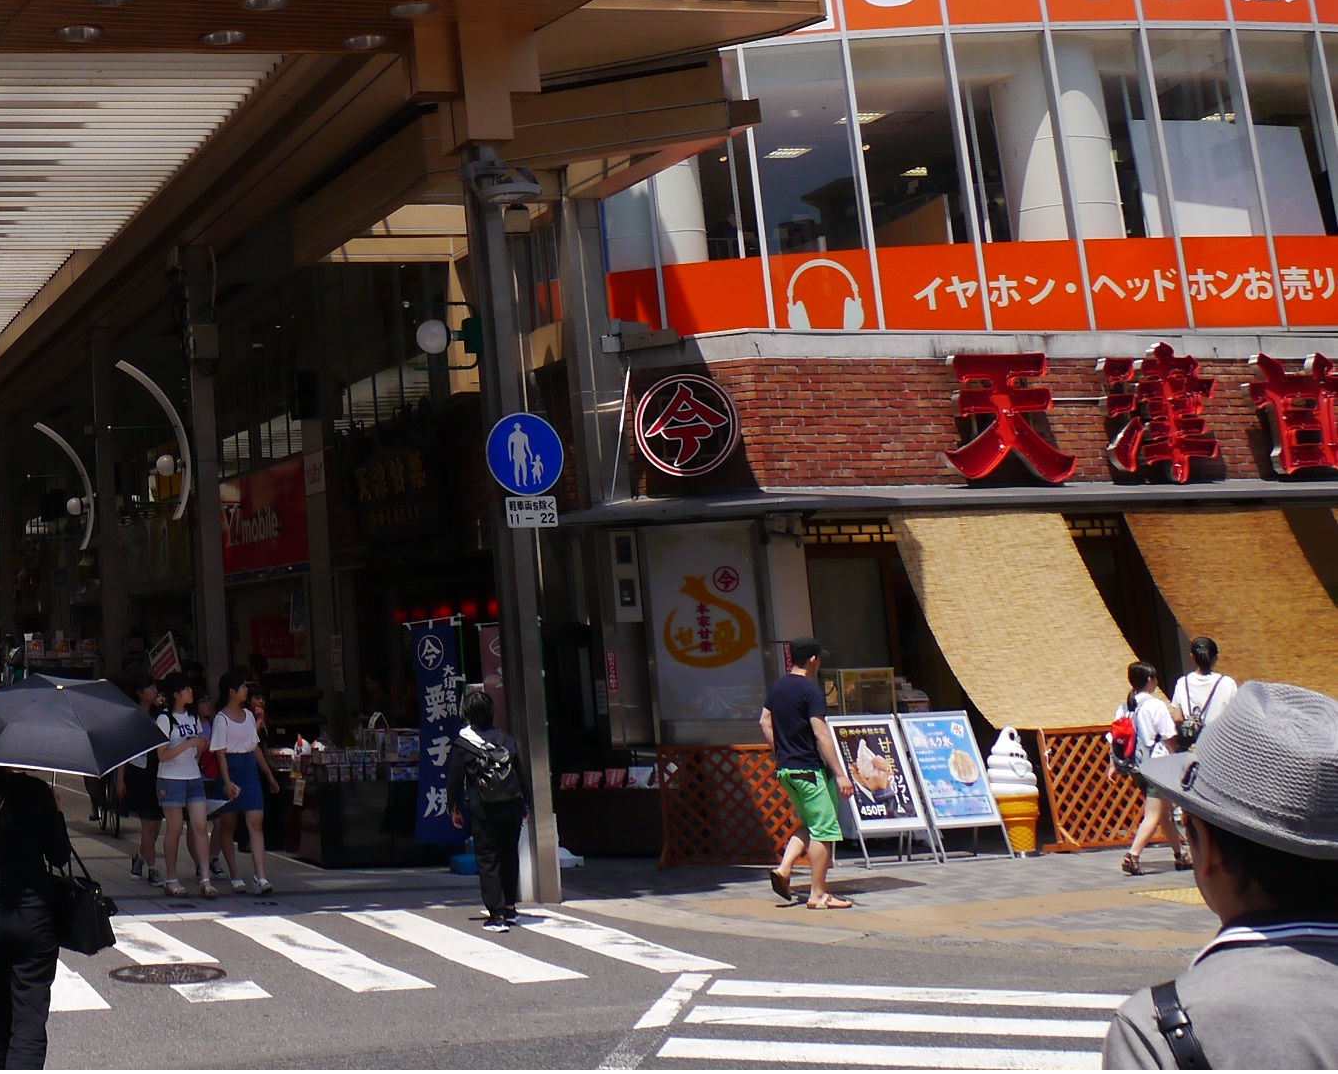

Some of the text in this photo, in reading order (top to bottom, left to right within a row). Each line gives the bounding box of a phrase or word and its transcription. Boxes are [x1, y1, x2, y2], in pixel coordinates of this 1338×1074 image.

[509, 501, 554, 511] 軽車両を除く
[861, 805, 887, 816] 450円
